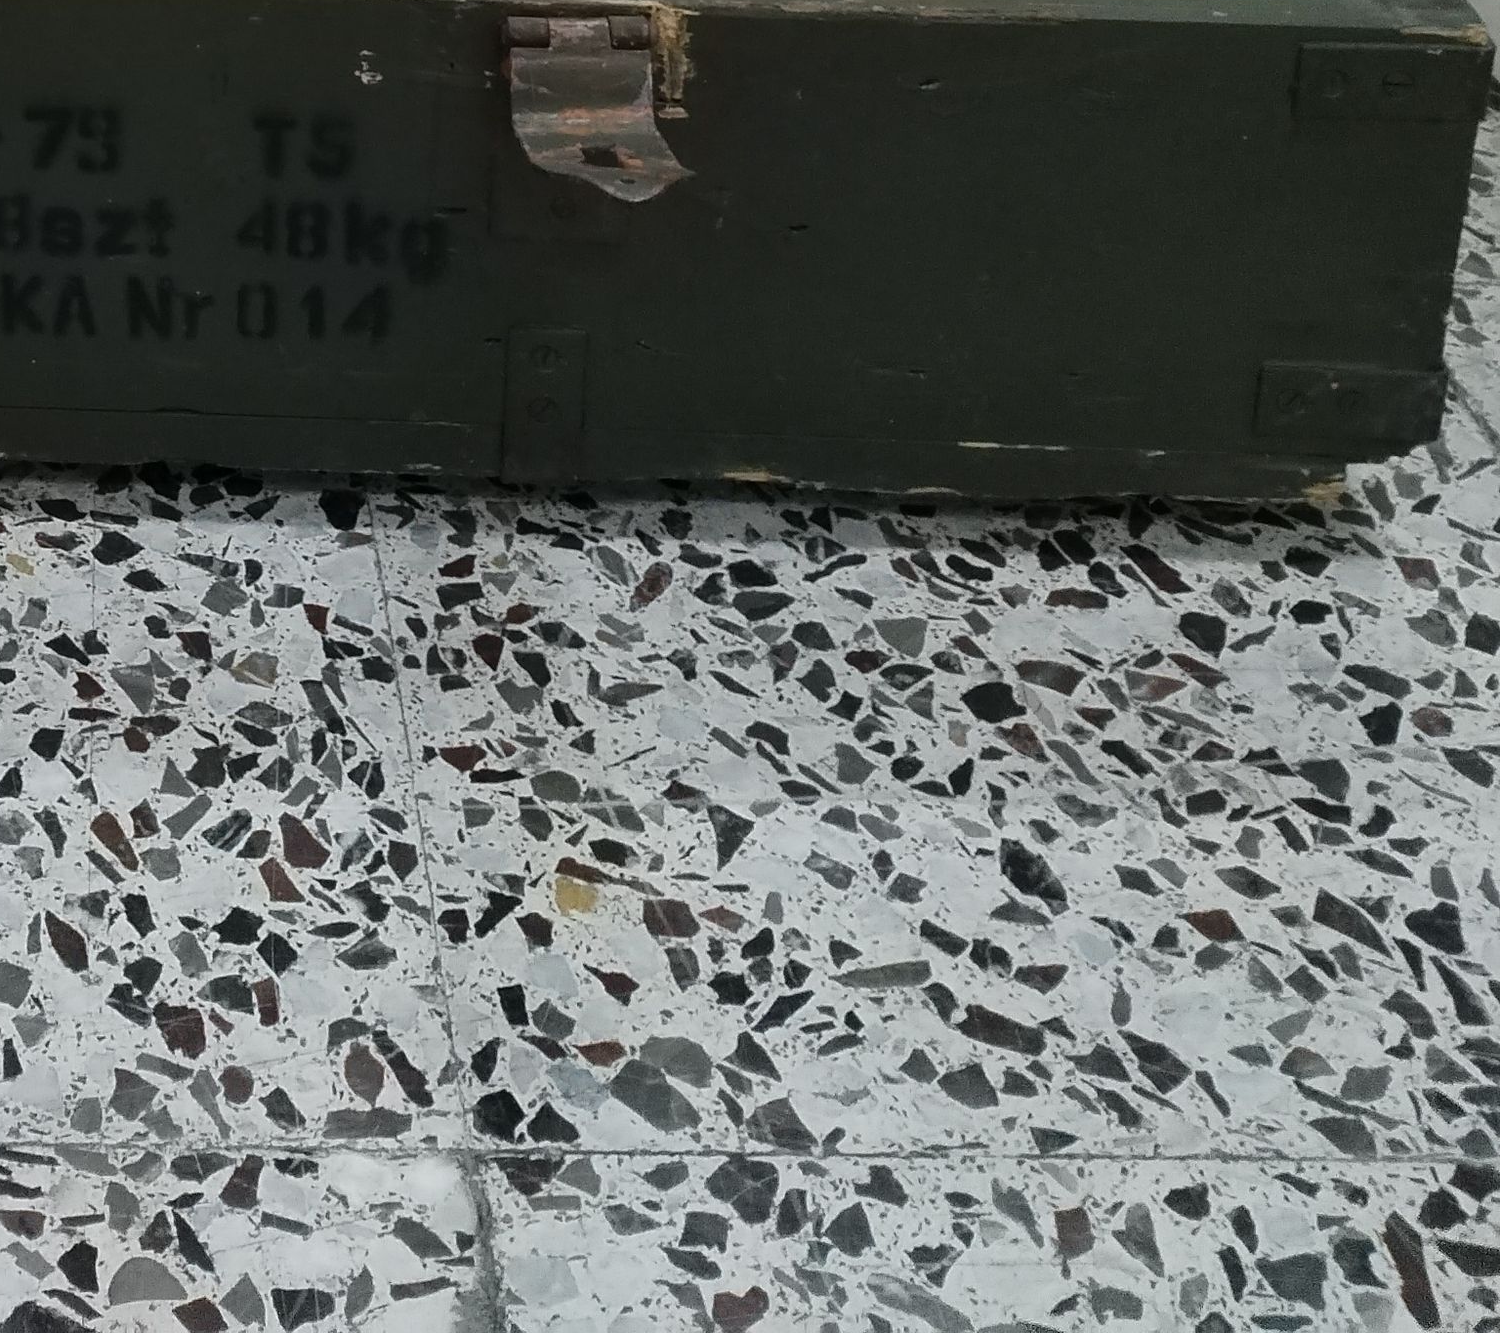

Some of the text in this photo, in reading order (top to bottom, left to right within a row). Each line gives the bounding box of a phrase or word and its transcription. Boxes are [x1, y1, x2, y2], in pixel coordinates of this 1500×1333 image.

[252, 109, 355, 178] TS
[126, 275, 214, 340] Nr
[237, 281, 390, 343] 014
